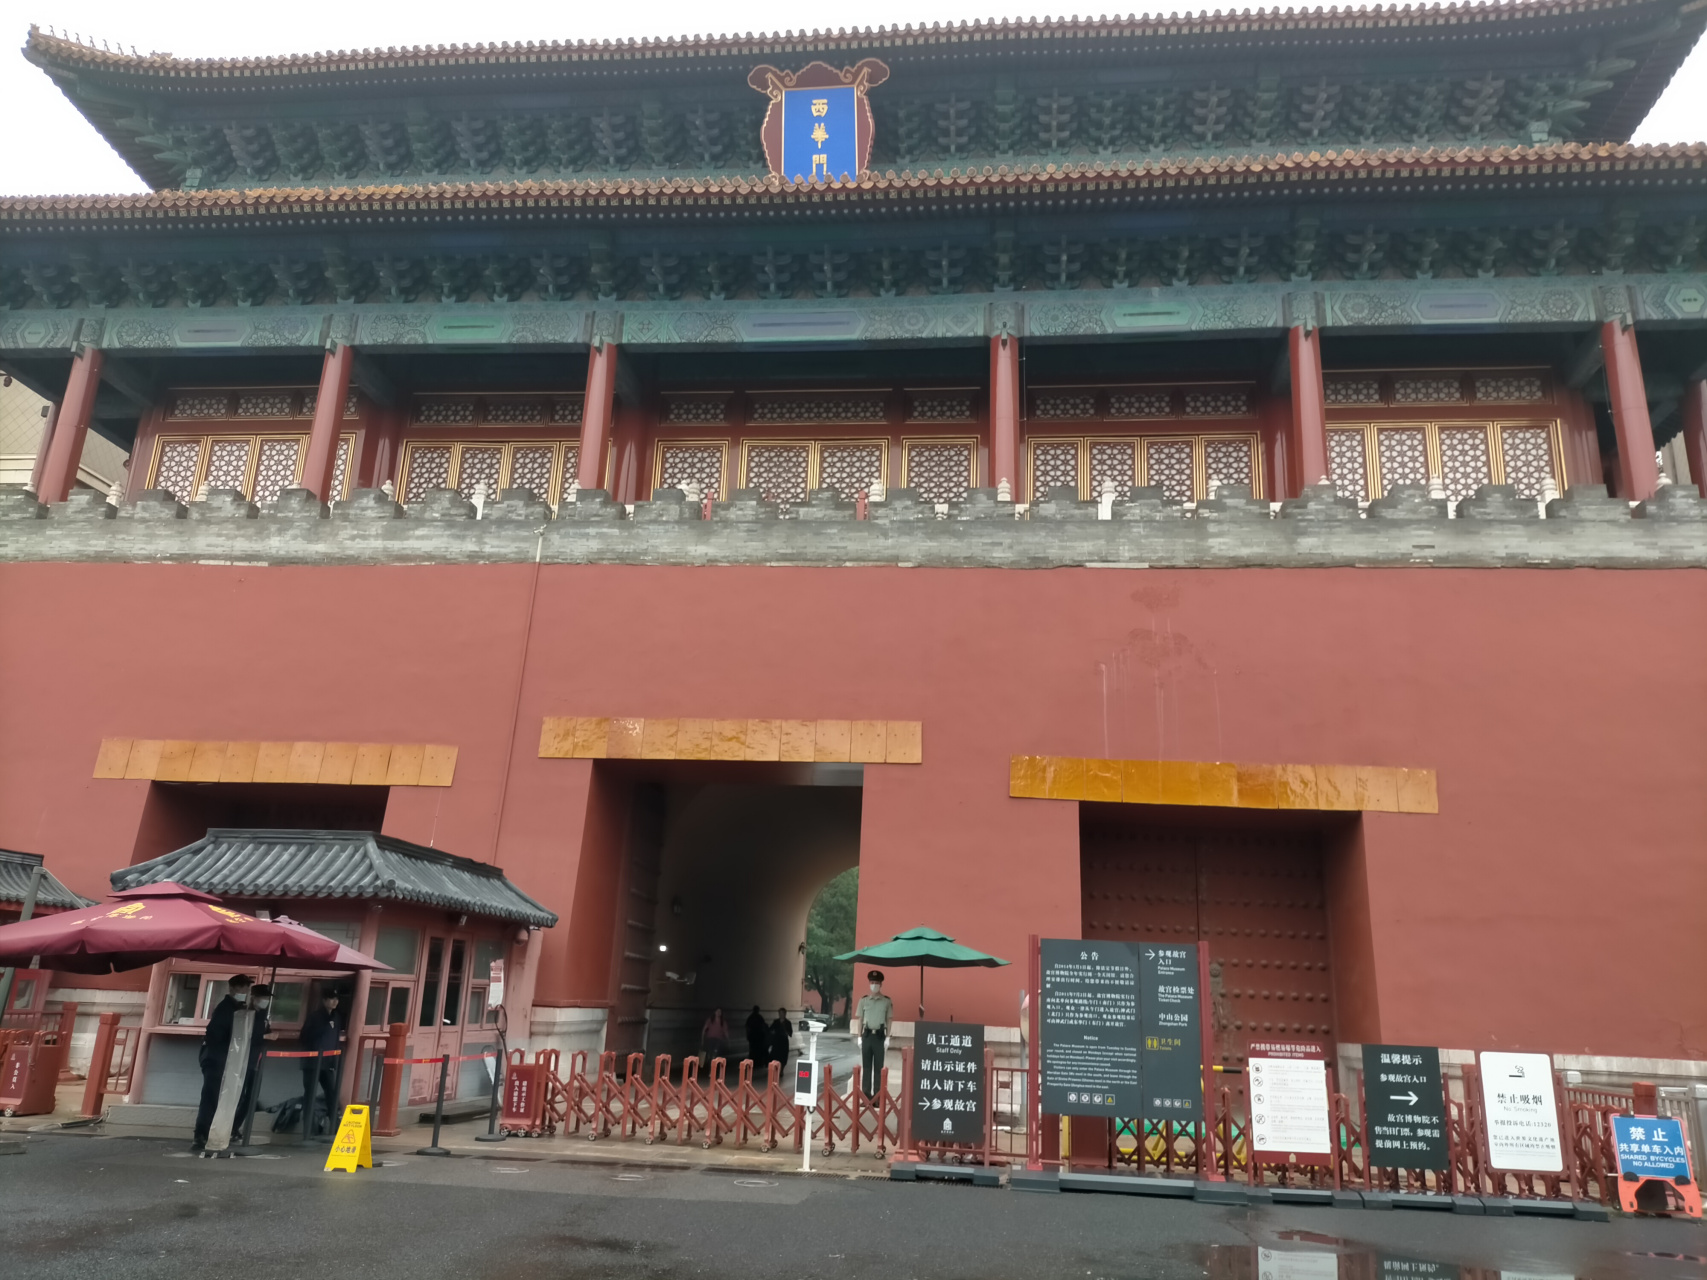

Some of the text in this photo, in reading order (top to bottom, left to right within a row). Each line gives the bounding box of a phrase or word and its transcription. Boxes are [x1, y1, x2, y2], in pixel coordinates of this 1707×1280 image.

[811, 99, 829, 176] 西華門
[1080, 951, 1099, 960] 公告
[1159, 950, 1186, 958] 参观故宫
[1158, 985, 1194, 994] 故宫检票处
[1159, 1013, 1188, 1022] 中山公园
[927, 1034, 972, 1047] 员工通道
[1161, 1038, 1181, 1046] 卫生间
[1381, 1053, 1422, 1065] 温馨提示
[921, 1059, 977, 1073] 请出示证件
[1380, 1073, 1426, 1083] 参观故宫入口
[931, 1098, 977, 1112] 参观故宫
[1497, 1093, 1543, 1105] 禁止吸烟
[1388, 1114, 1439, 1124] 故宫博物院不
[1375, 1126, 1440, 1138] 售当日门票，参观需
[1630, 1126, 1668, 1141] 禁止
[335, 1145, 356, 1154] 小心地滑
[1375, 1139, 1430, 1151] 提前网上预约。
[1619, 1143, 1684, 1156] 共享单车入内
